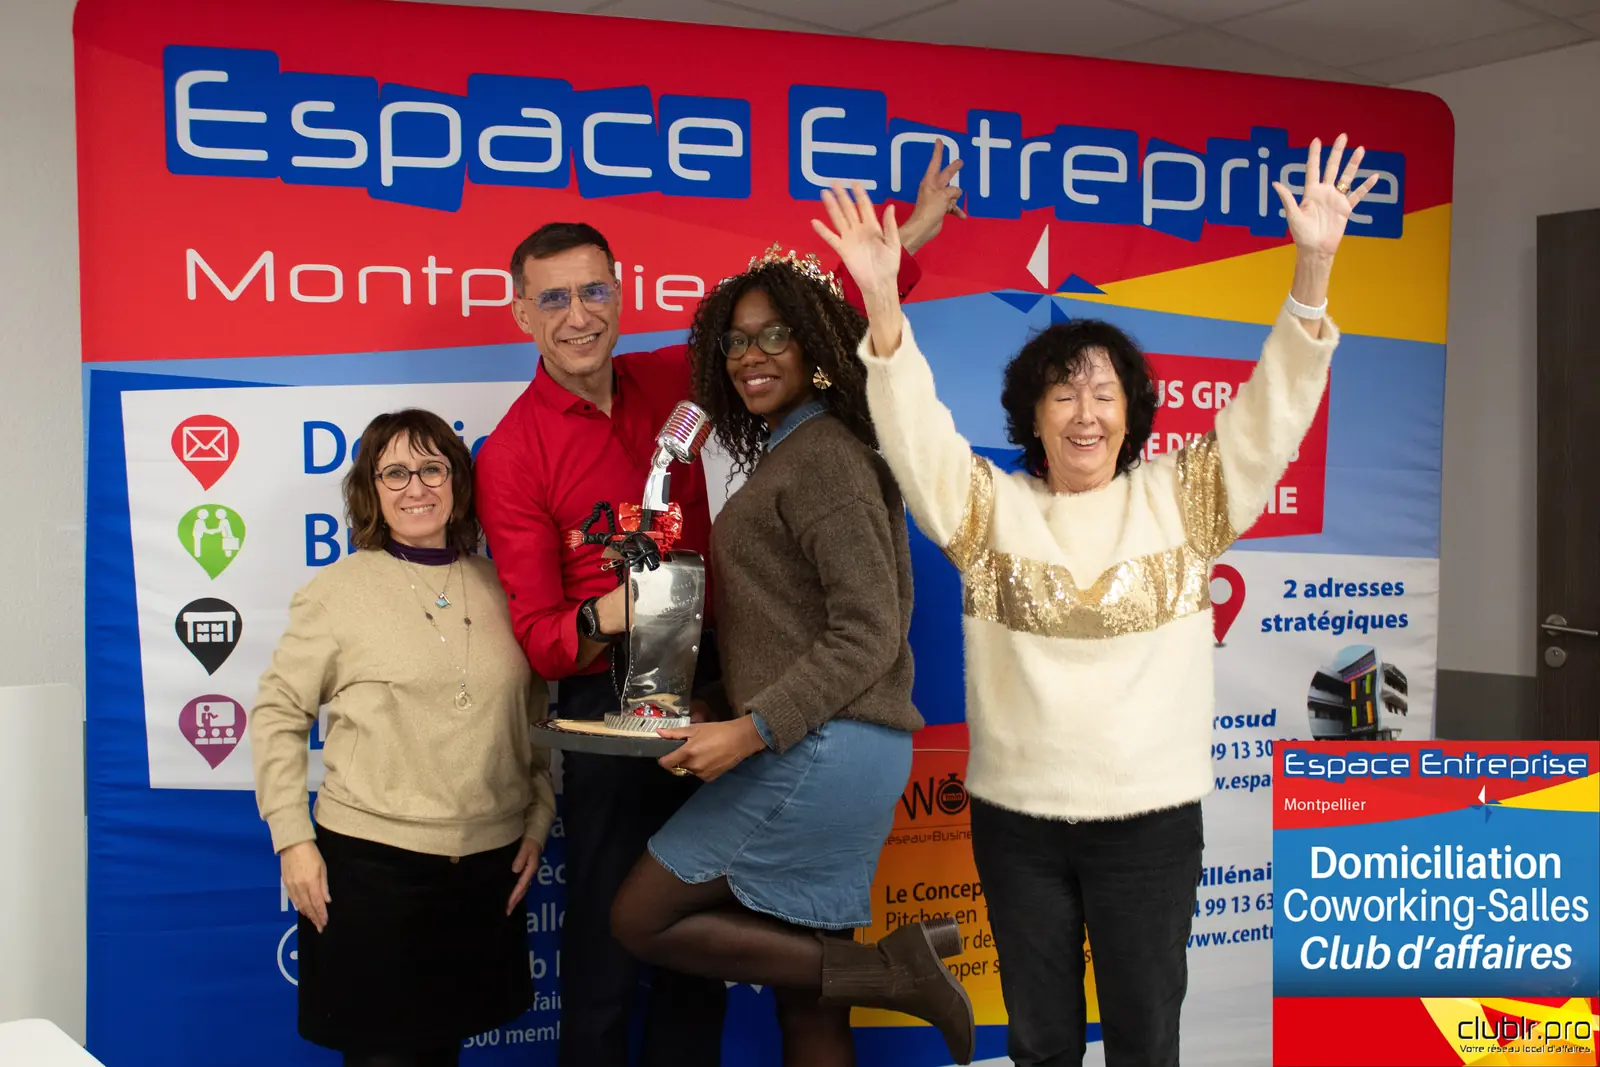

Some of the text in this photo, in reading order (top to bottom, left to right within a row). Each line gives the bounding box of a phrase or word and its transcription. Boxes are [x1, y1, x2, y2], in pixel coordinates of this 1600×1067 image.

[174, 70, 1399, 226] Espace Entreprise
[1283, 577, 1405, 599] 2 adresses
[1261, 609, 1409, 636] stratégiques
[1231, 741, 1251, 760] 13
[1198, 861, 1273, 888] illénai
[886, 885, 908, 904] Le
[955, 908, 978, 924] en
[1205, 897, 1227, 917] 99
[1231, 895, 1251, 913] 13
